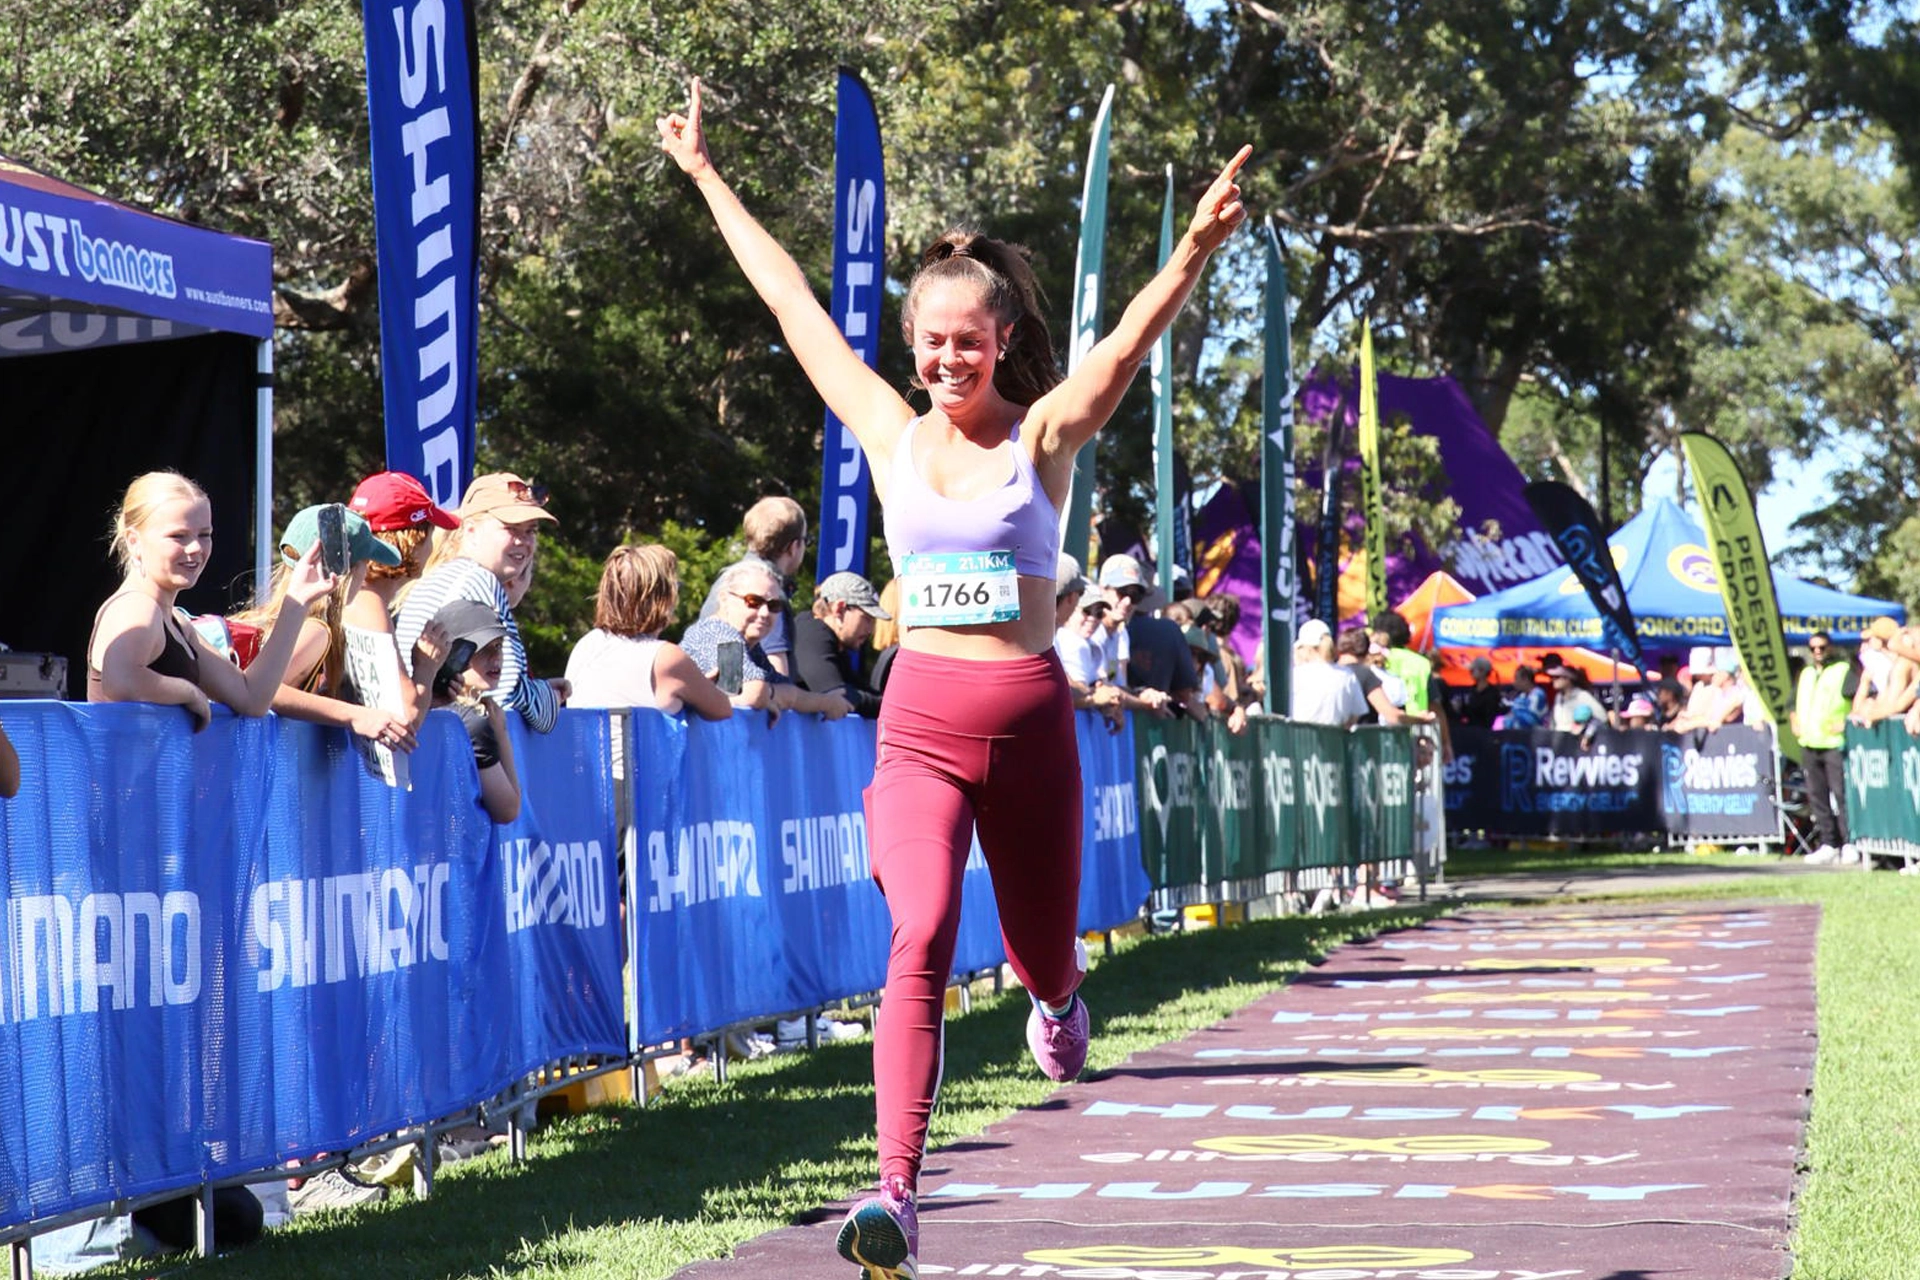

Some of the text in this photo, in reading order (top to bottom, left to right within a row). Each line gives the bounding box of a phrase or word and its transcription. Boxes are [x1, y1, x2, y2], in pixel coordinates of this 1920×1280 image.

[70, 219, 177, 300] banners
[185, 286, 271, 314] www.austbanners.com
[959, 554, 1009, 570] 21.1KM
[923, 582, 990, 607] 1766
[1735, 535, 1788, 726] PEDESTRIAN
[1536, 745, 1641, 787] Revvies
[1193, 1046, 1755, 1058] HUSKY
[1082, 1101, 1734, 1121] HUSKY
[929, 1182, 1708, 1200] HUSKY
